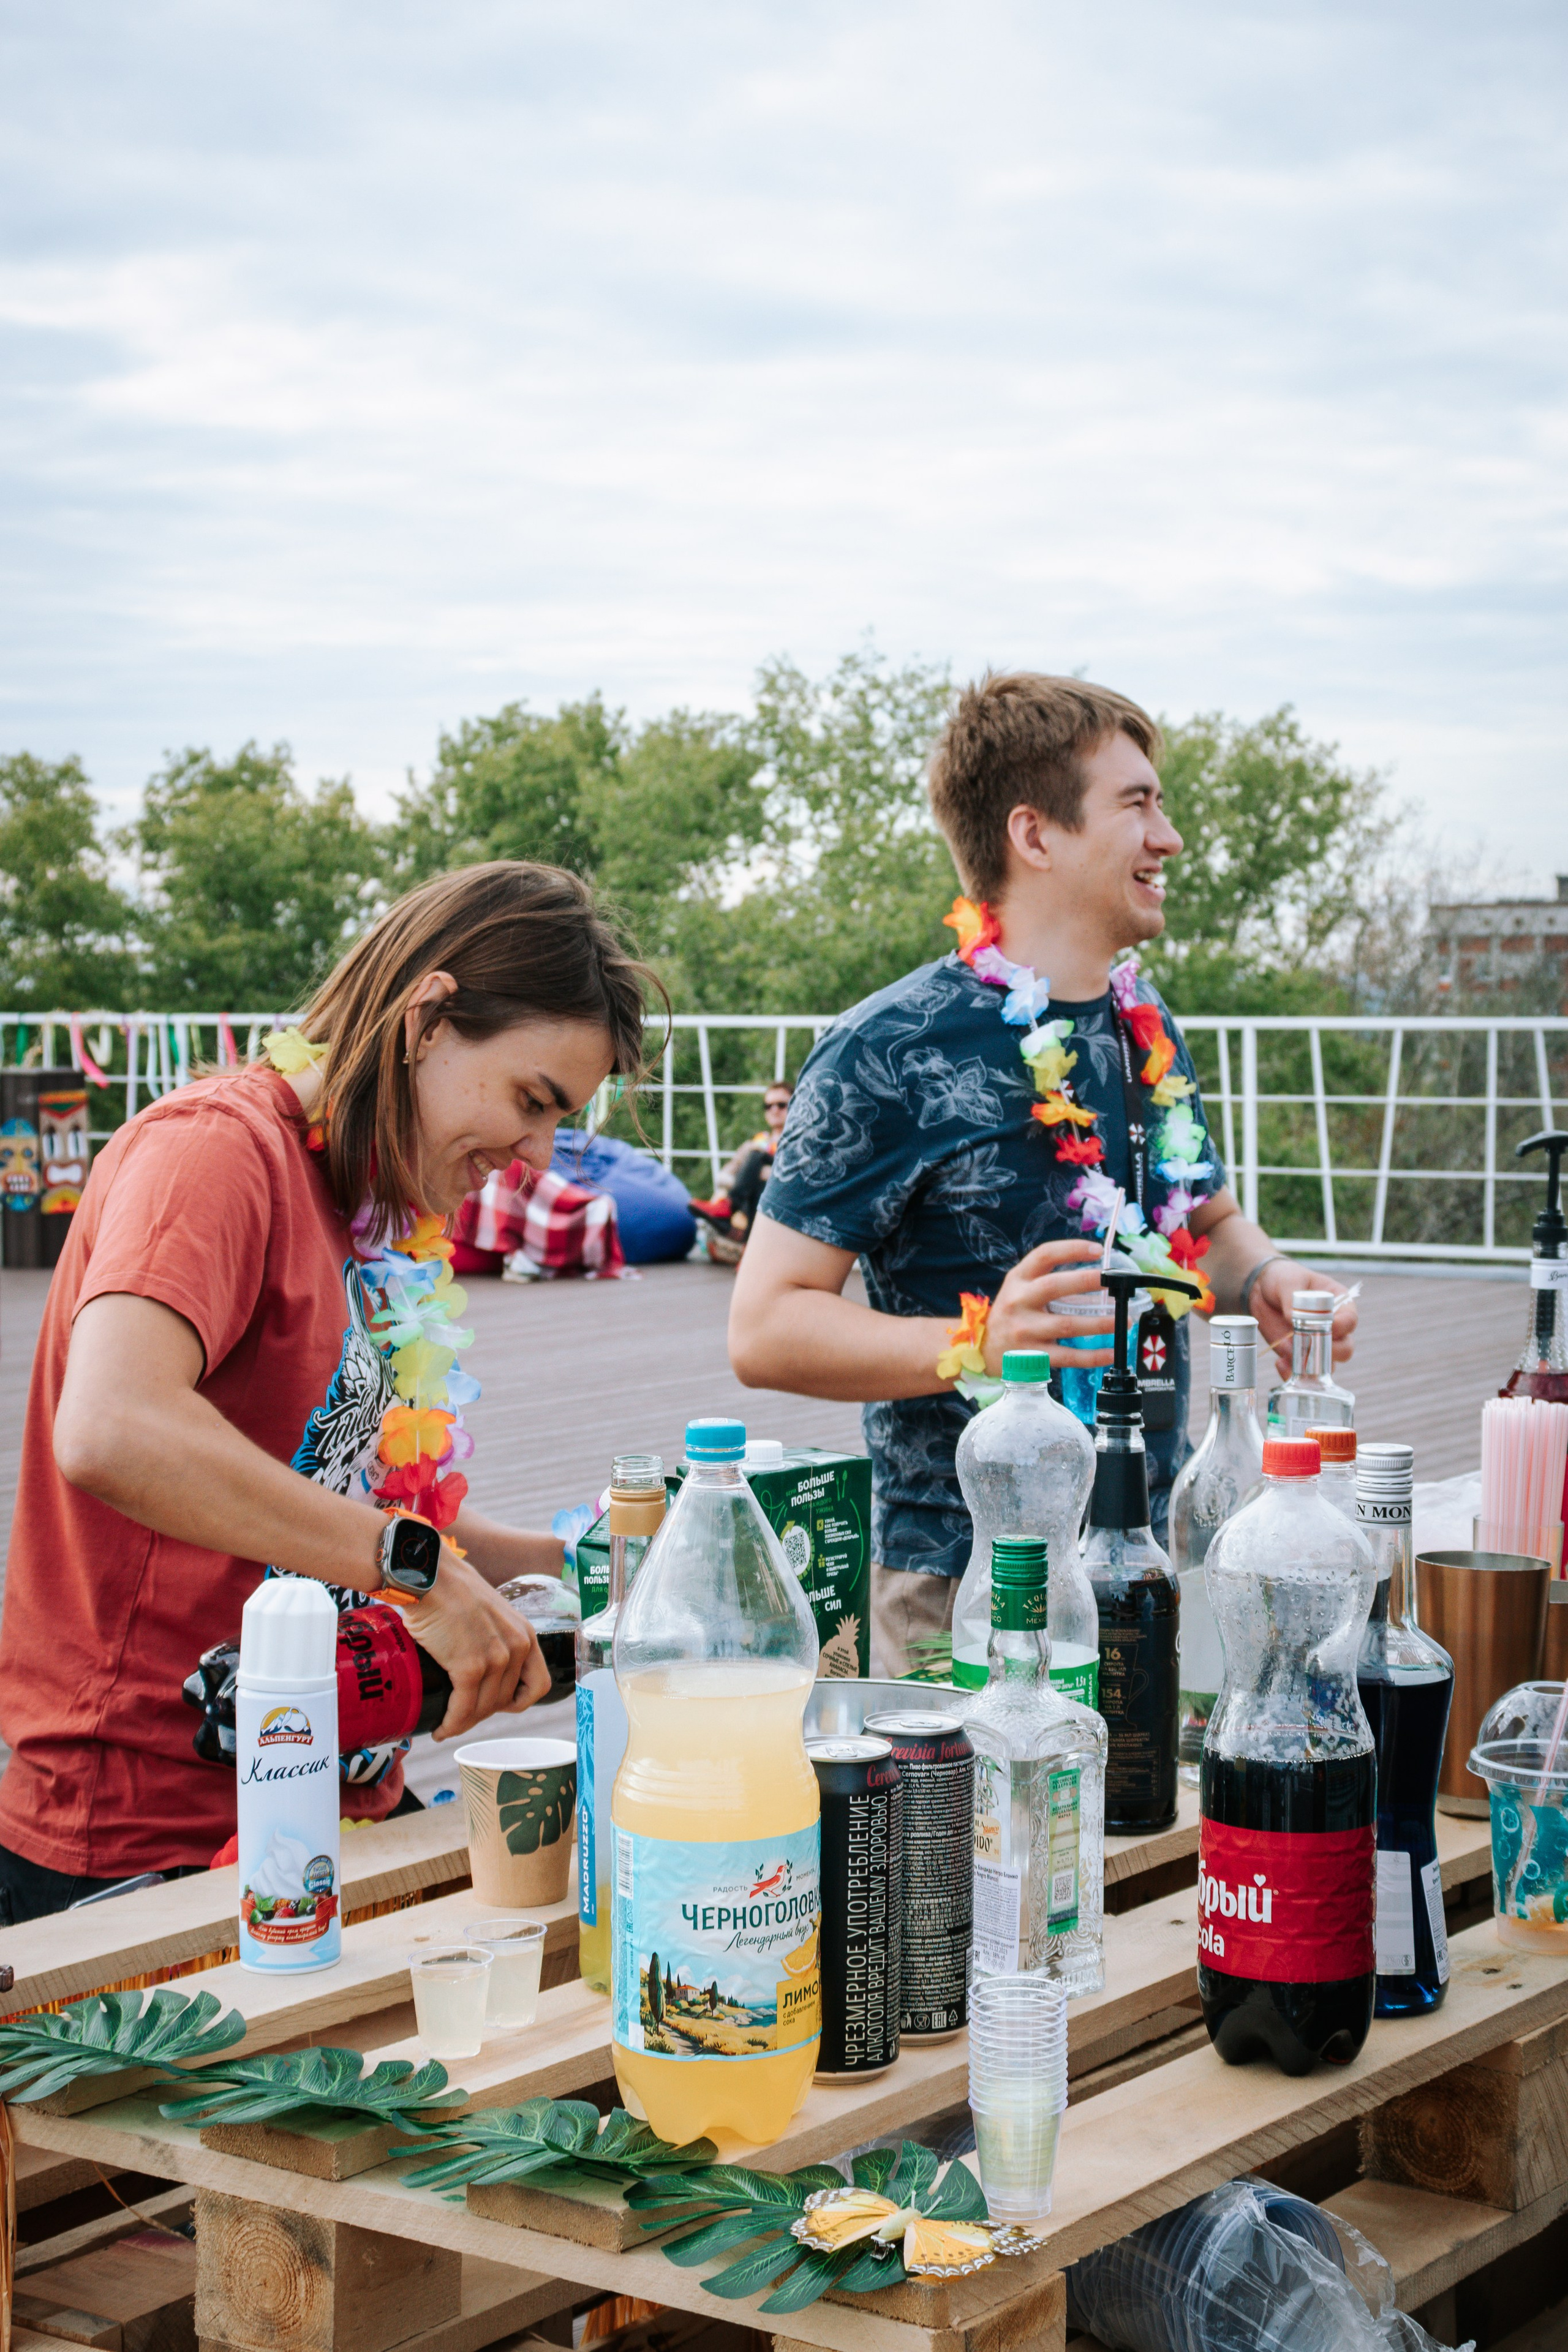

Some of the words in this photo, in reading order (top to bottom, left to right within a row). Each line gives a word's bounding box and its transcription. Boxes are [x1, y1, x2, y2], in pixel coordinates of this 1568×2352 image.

[1223, 1330, 1236, 1382] BARCELÓ
[1137, 1378, 1175, 1387] MBRELLA
[797, 1470, 835, 1493] БОЛЬШЕ
[791, 1487, 824, 1507] ПОЛЬЗЫ
[590, 1565, 609, 1575] БОЛЬ
[805, 1585, 835, 1604] ЛЬШЕ
[824, 1599, 842, 1611] СИЛ
[337, 1615, 393, 1702] брый
[1105, 1647, 1121, 1660] 16
[259, 1735, 312, 1746] АЛЬПЕНГУРТ
[241, 1755, 330, 1785] Классик
[922, 1762, 952, 1771] фильтрованное
[870, 1791, 889, 1871] ЗДОРОВЬЮ.
[796, 1868, 816, 1881] МОМЕНТА
[847, 1795, 870, 1937] УПОТРЕБЛЕНИЕ
[869, 1875, 886, 1934] ВАШЕМУ
[1198, 1860, 1272, 1924] брый
[723, 1928, 793, 1953] Легендарный
[795, 1919, 809, 1942] вкус
[868, 1939, 886, 1984] ВРЕДИТ
[783, 1979, 821, 2009] ЛИМО
[845, 1944, 867, 2065] ЧРЕЗМЕРНОЕ
[783, 2018, 795, 2026] сока
[867, 1986, 884, 2062] АЛКОГОЛЯ
